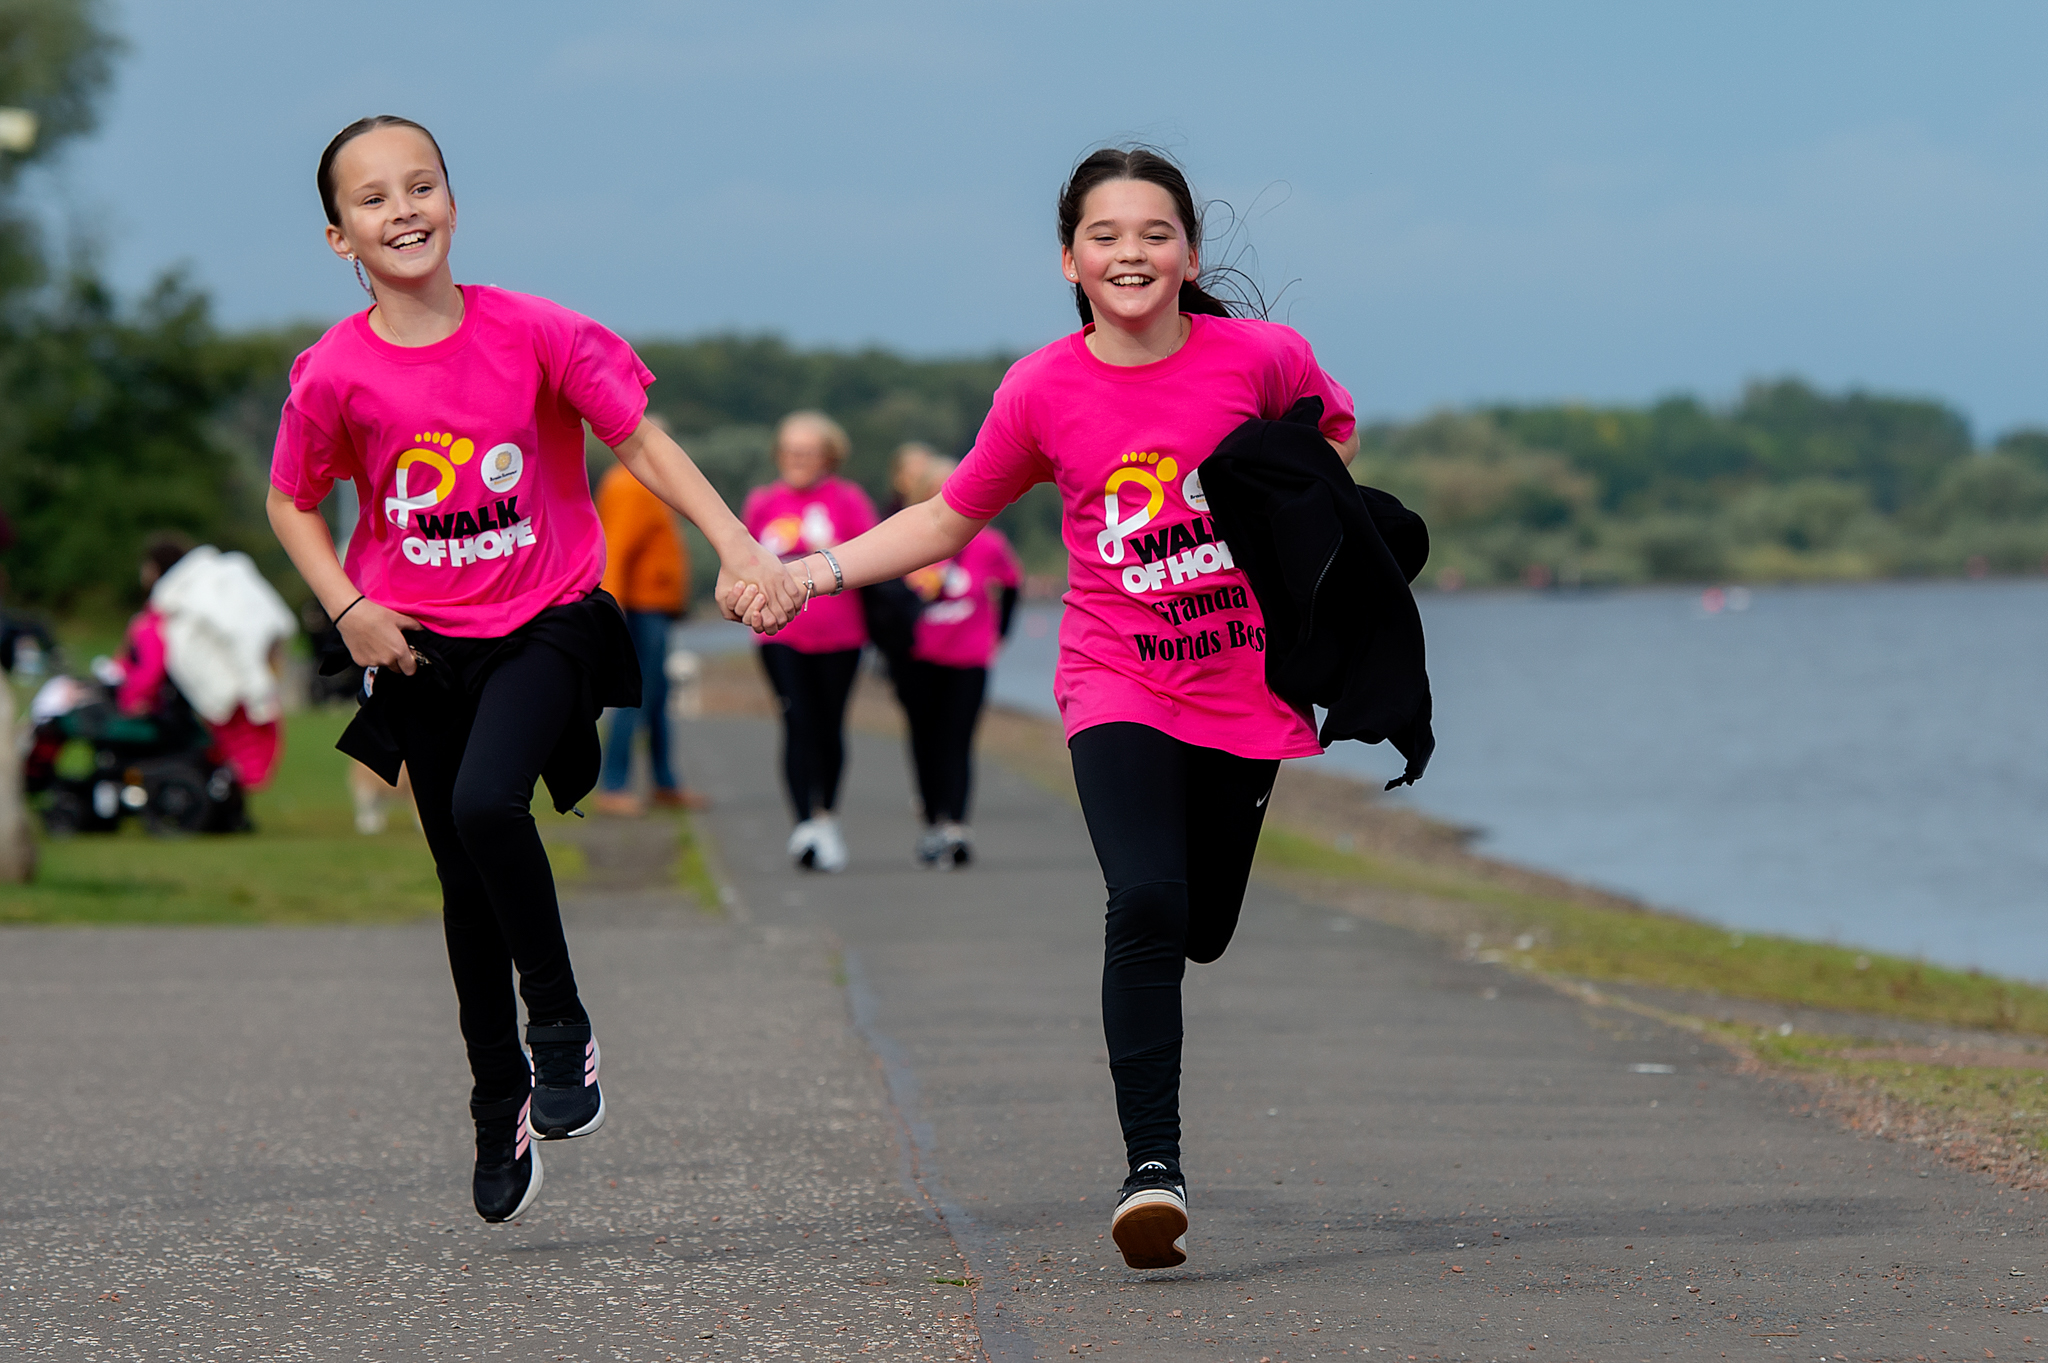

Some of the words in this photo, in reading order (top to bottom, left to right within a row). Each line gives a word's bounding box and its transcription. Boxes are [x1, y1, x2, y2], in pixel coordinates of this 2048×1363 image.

[415, 495, 522, 540] WALK
[402, 537, 448, 567] OF
[449, 516, 537, 567] HOPE
[1128, 517, 1216, 565] WAL
[1122, 561, 1167, 594] OF
[1166, 541, 1235, 585] HO
[1151, 585, 1249, 627] Granda
[1226, 620, 1266, 653] Bes
